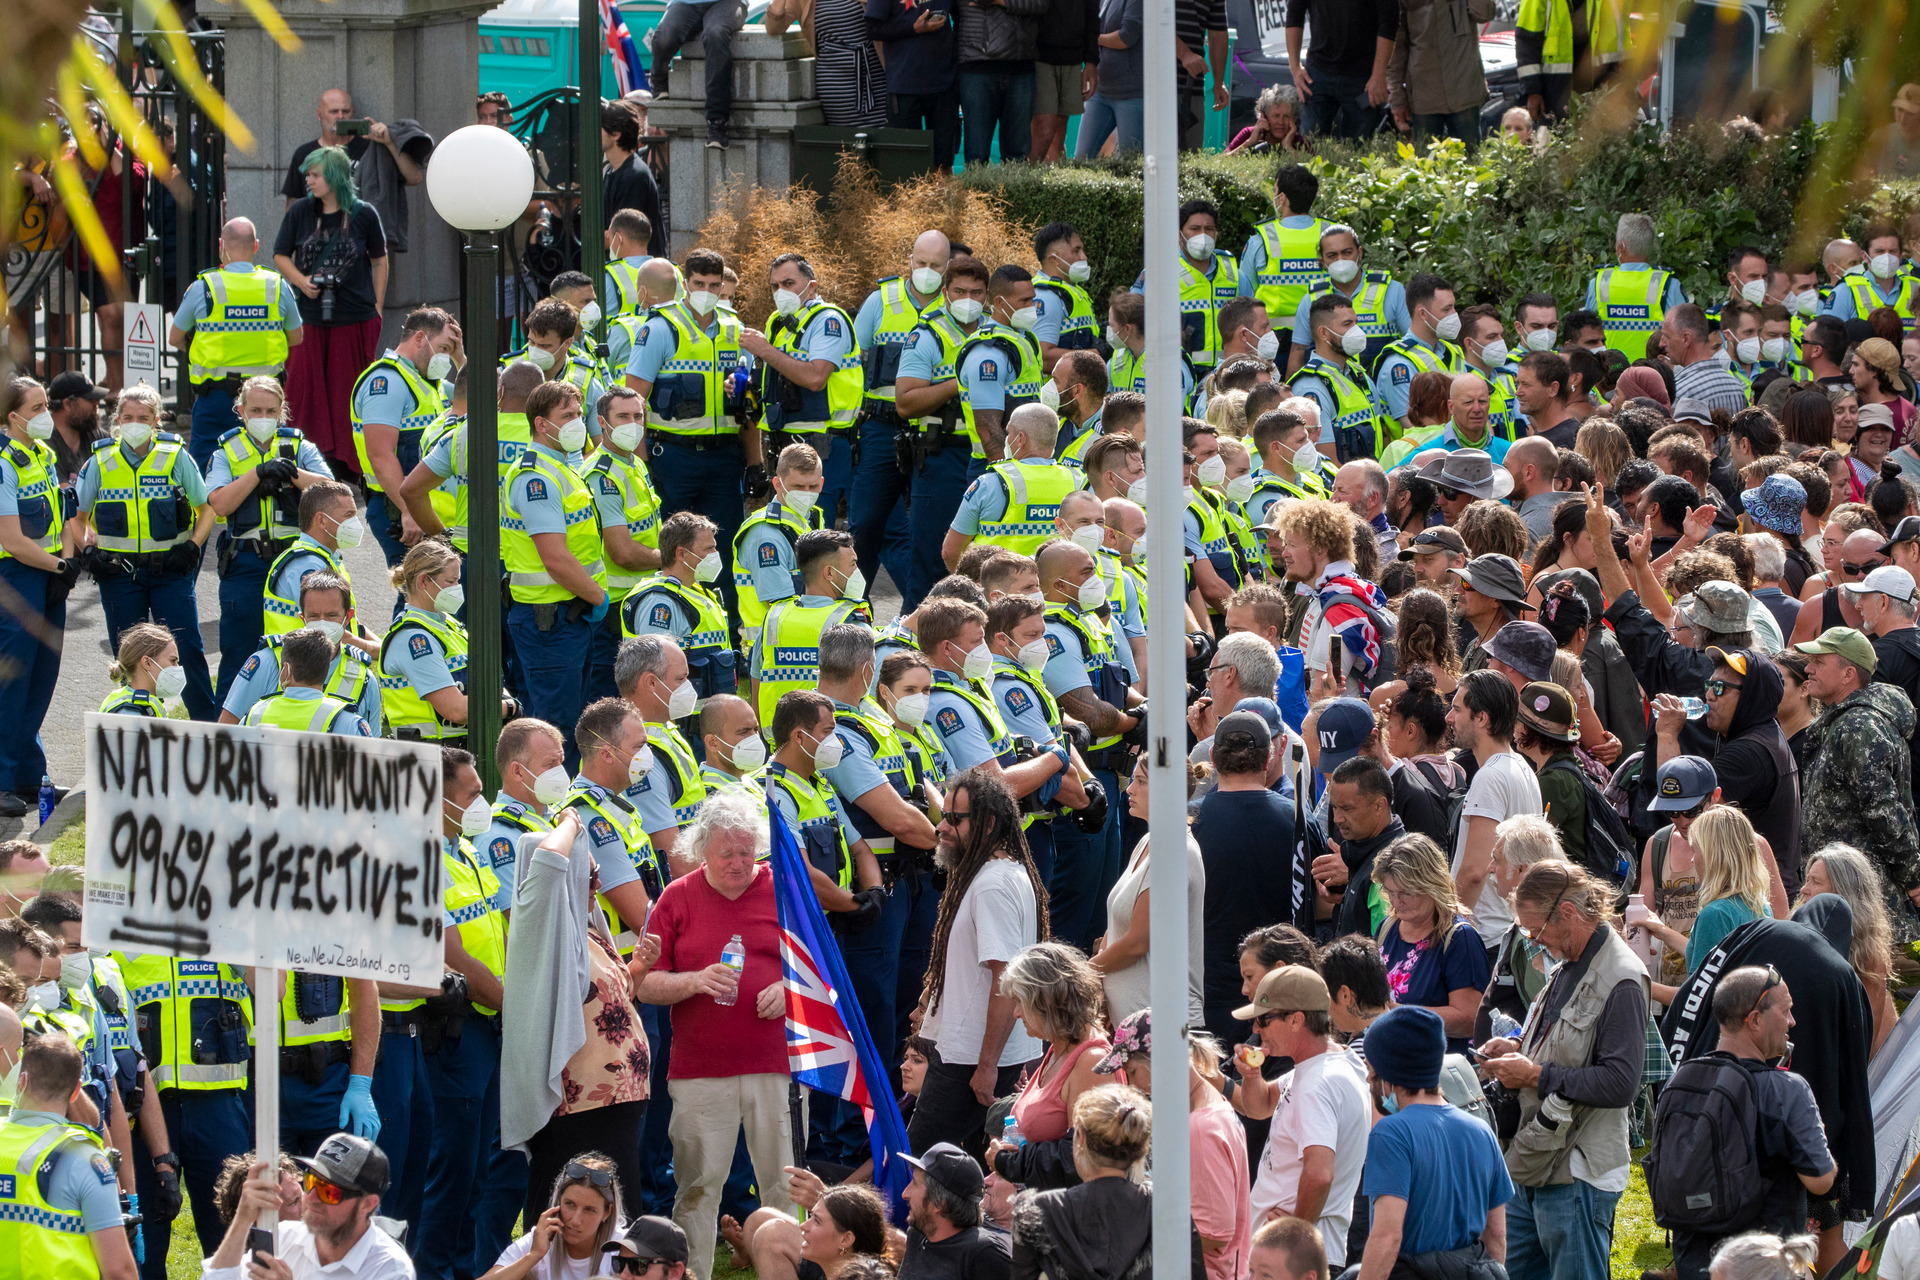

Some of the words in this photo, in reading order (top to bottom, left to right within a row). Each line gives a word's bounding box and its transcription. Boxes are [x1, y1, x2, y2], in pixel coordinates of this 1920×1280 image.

[1283, 261, 1320, 269] POLICE
[227, 308, 265, 317] POLICE
[1609, 308, 1645, 316] POLICE
[133, 348, 150, 358] Rising
[130, 358, 152, 367] bollards
[1030, 508, 1059, 518] POLI
[778, 651, 817, 662] POLICE
[1319, 731, 1338, 750] NY
[98, 723, 277, 808] NATURAL
[298, 737, 438, 814] IMMUNITY
[630, 785, 650, 794] POLICE
[599, 836, 617, 845] POLICE
[495, 857, 513, 866] POLICE
[227, 827, 442, 942] EFFECTIVE!!
[287, 944, 411, 981] NewNewZealand.org
[182, 964, 215, 972] POLICE
